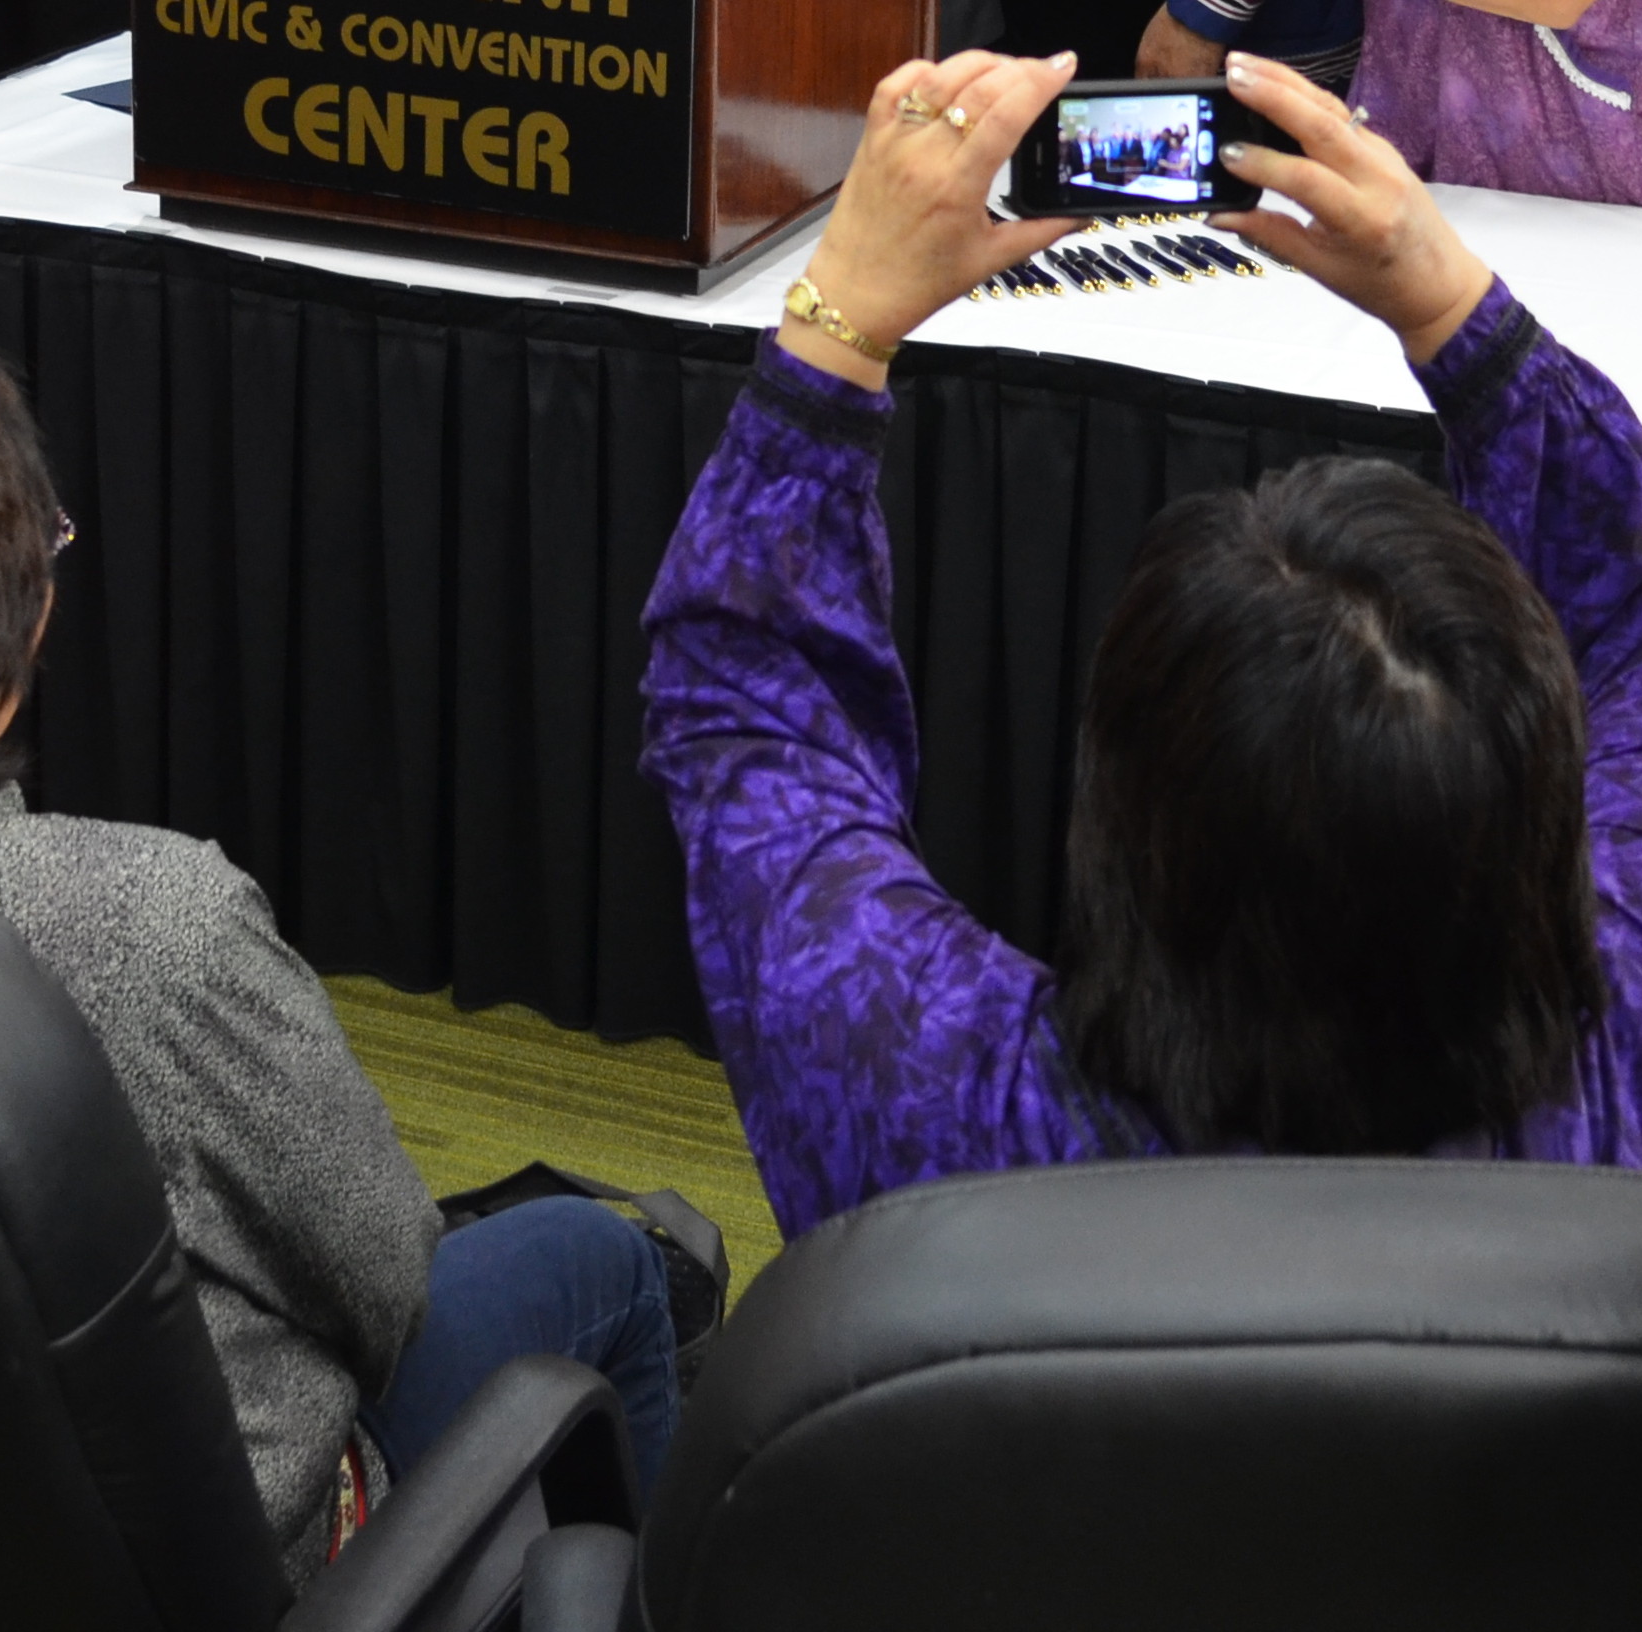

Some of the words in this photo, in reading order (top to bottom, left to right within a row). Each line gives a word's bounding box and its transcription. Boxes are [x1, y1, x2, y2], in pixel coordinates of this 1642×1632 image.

[286, 6, 324, 52] &
[341, 14, 667, 97] CONVENTION
[244, 78, 570, 195] CENTER
